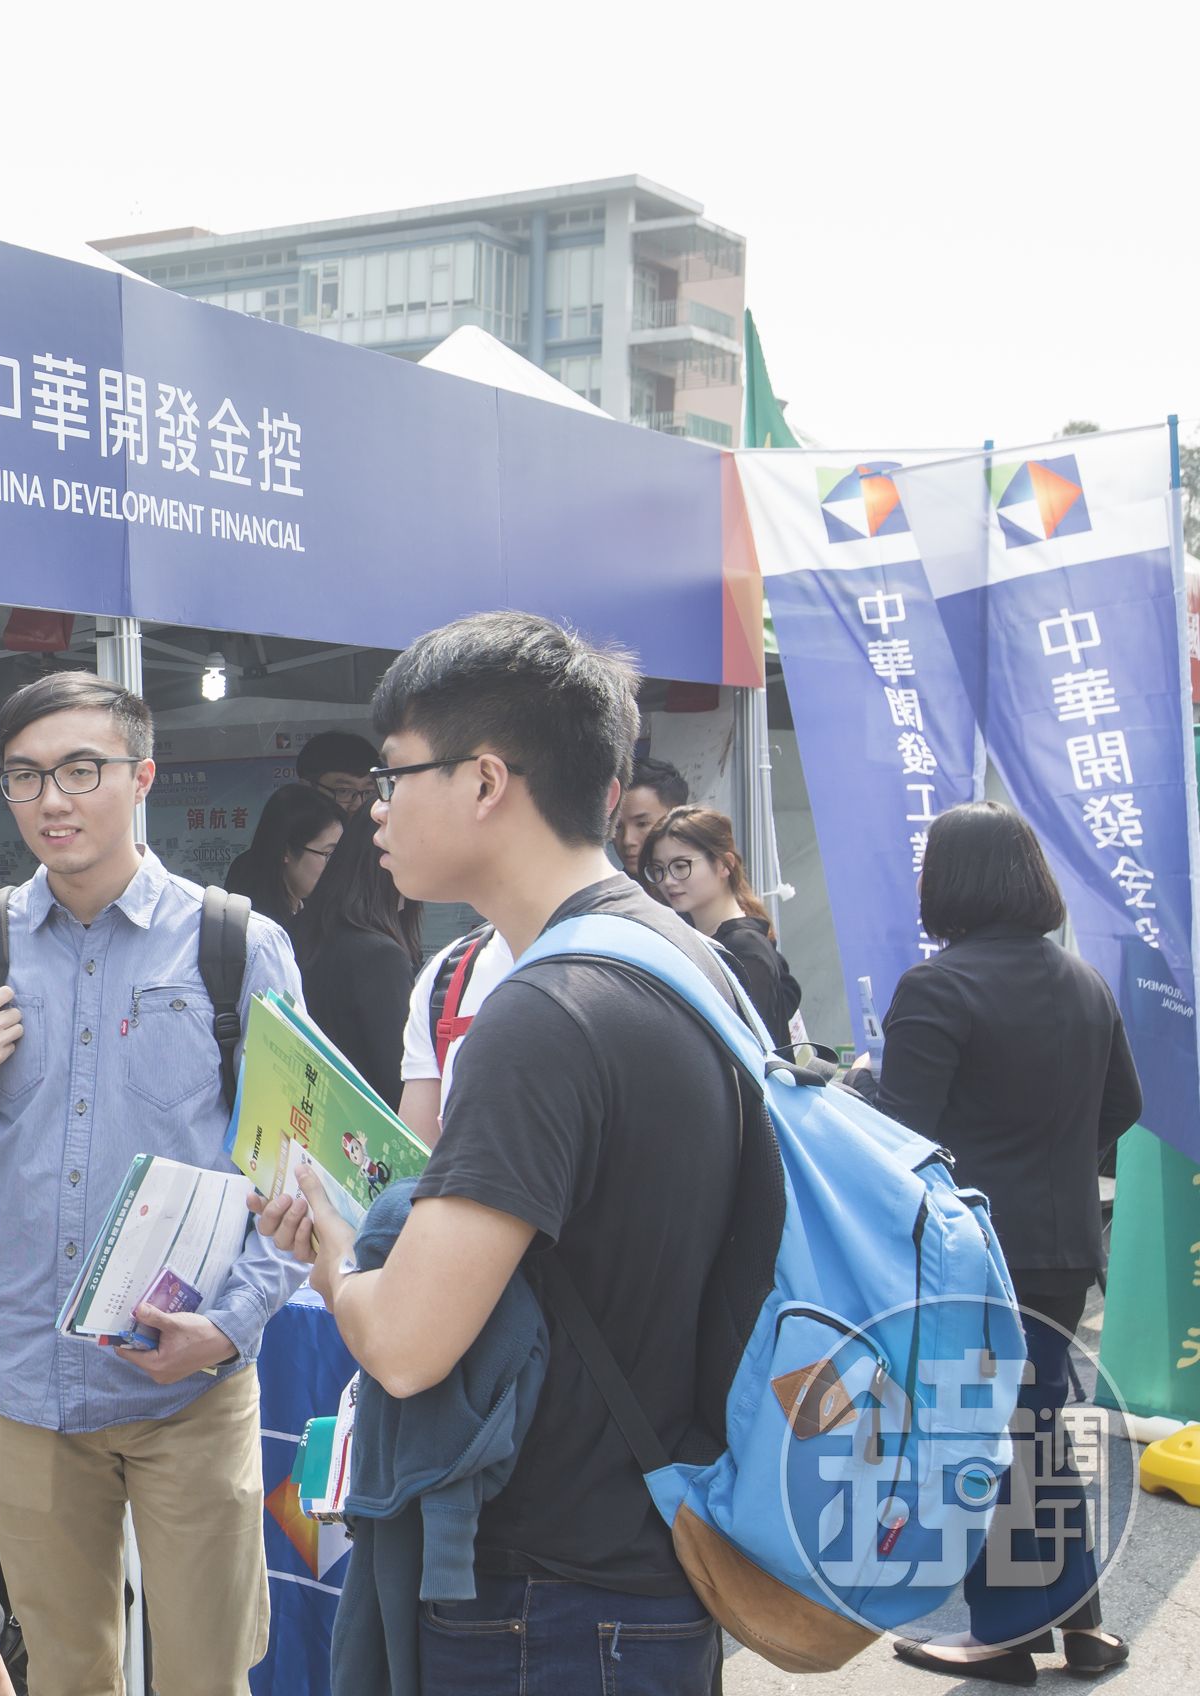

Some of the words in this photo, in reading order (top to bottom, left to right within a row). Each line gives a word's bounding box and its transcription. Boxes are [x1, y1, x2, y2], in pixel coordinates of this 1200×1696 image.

[53, 479, 205, 535] DEVELOPMENT
[211, 508, 306, 552] FINANCIAL
[187, 806, 249, 831] 領航者
[193, 847, 232, 862] SUCCESS
[289, 1063, 318, 1150] 同在一起
[252, 1124, 264, 1161] TATUNG
[300, 1422, 313, 1447] 2017
